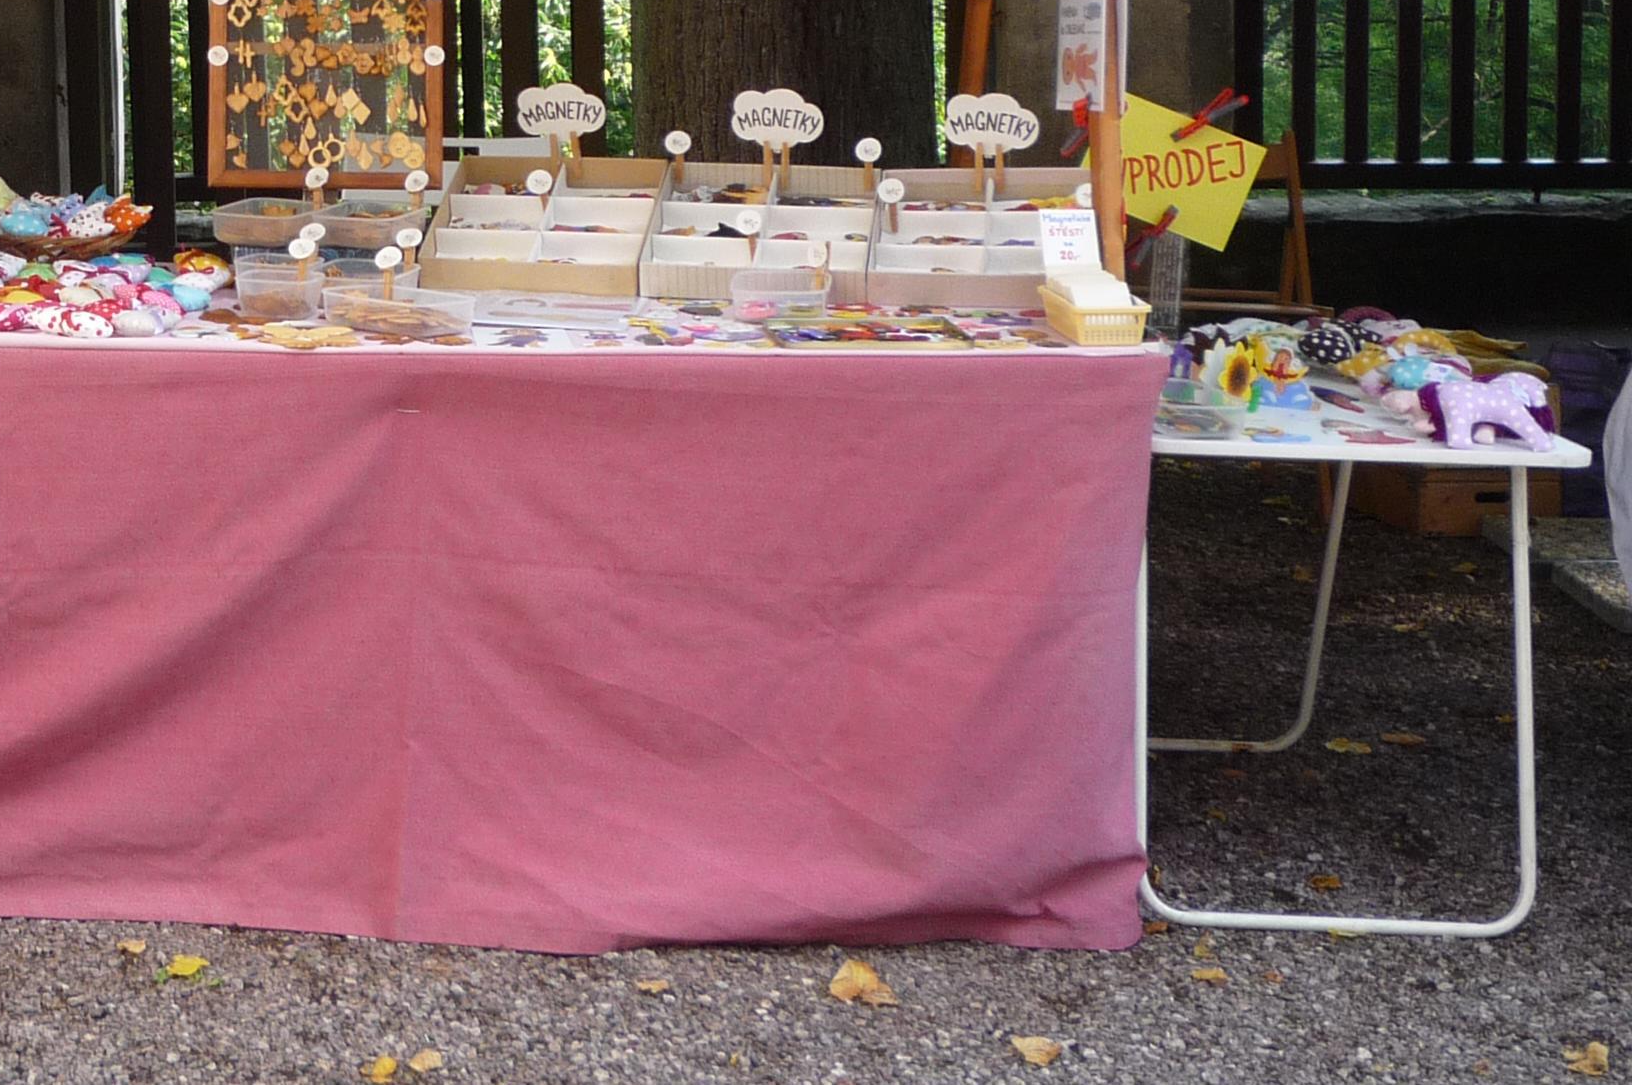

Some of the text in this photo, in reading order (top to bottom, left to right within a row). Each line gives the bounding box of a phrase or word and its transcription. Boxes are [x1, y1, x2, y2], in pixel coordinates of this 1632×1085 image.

[521, 101, 602, 127] MAGNETKY
[736, 107, 821, 135] MAGNETKY
[949, 110, 1037, 141] MAGNETKY
[1122, 140, 1246, 195] PRODEJ
